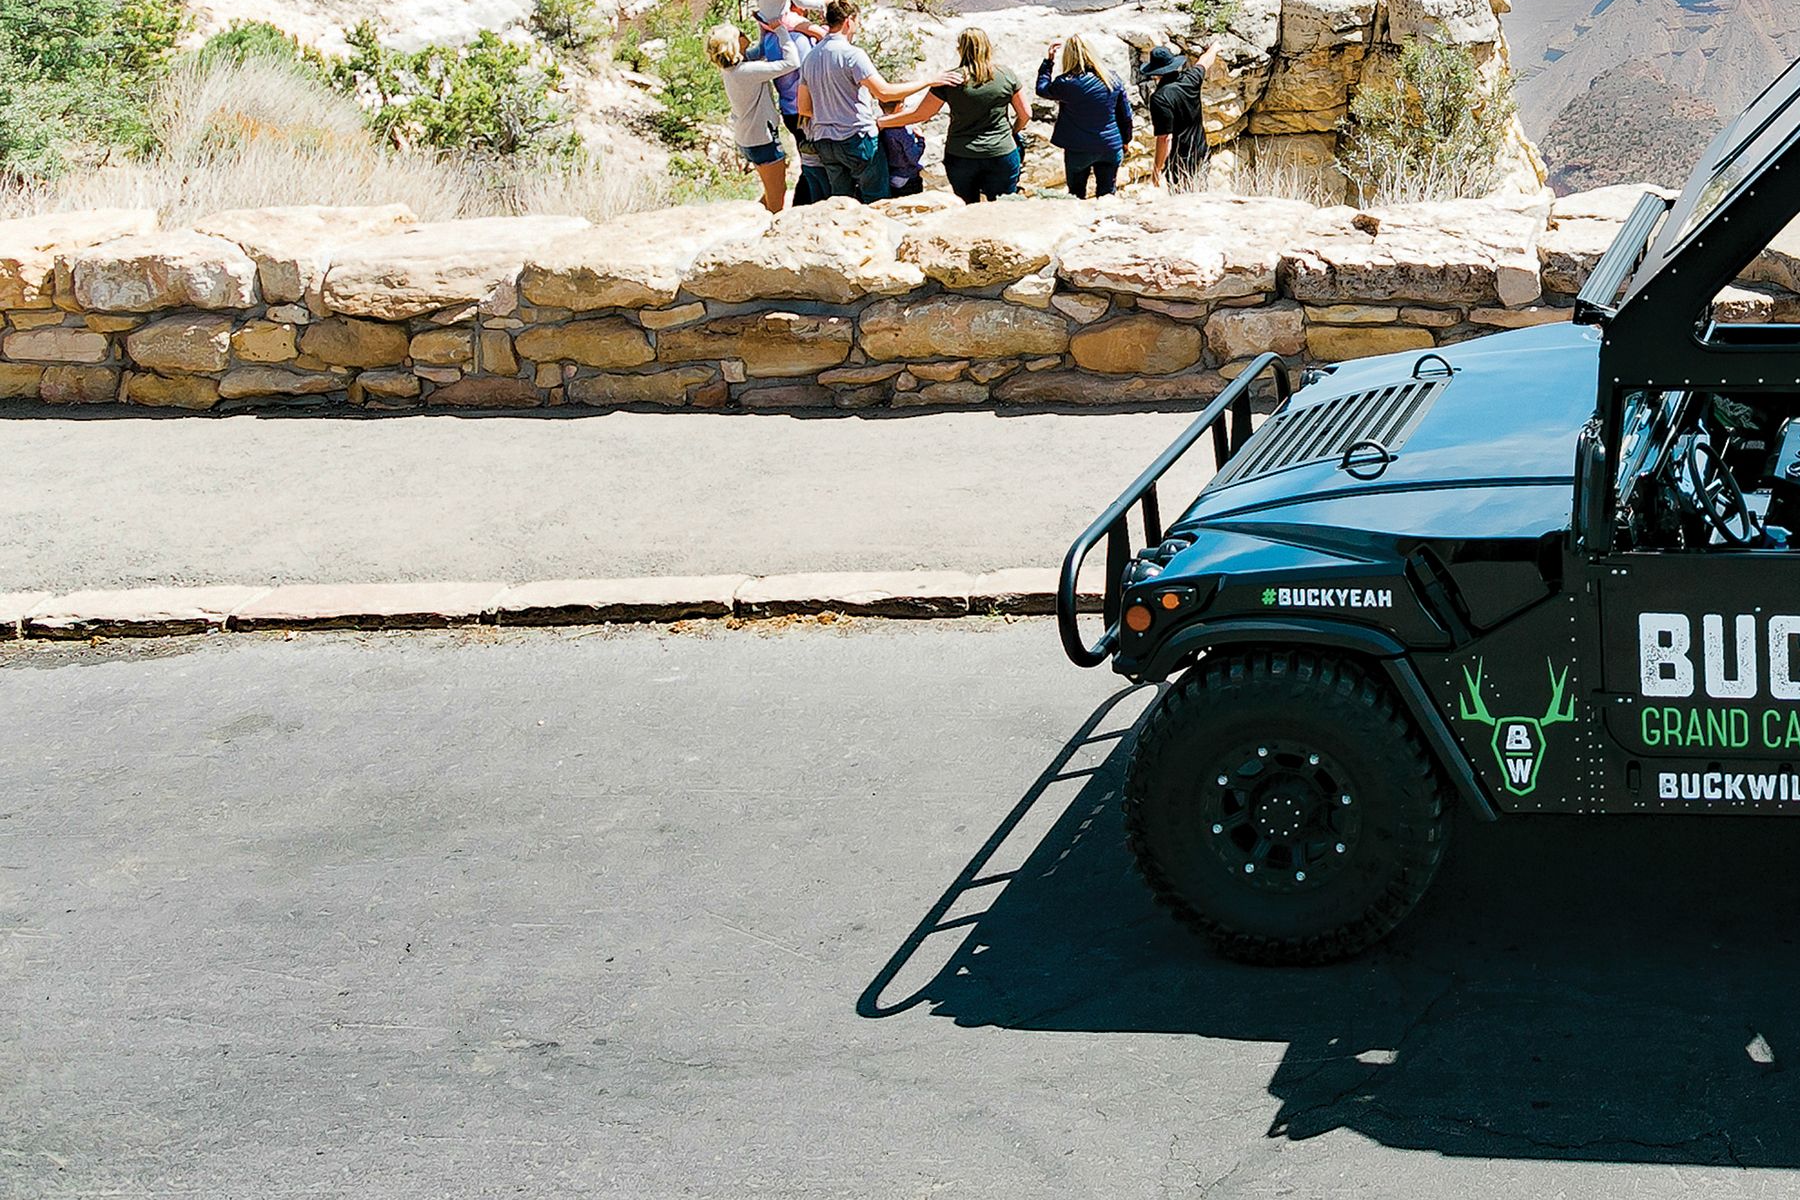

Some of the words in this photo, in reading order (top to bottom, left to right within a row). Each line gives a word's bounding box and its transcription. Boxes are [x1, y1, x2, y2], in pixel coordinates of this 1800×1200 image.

[1261, 587, 1393, 608] #BUCKYEAH
[1505, 724, 1532, 750] B
[1641, 707, 1749, 748] GRAND
[1506, 758, 1533, 784] W
